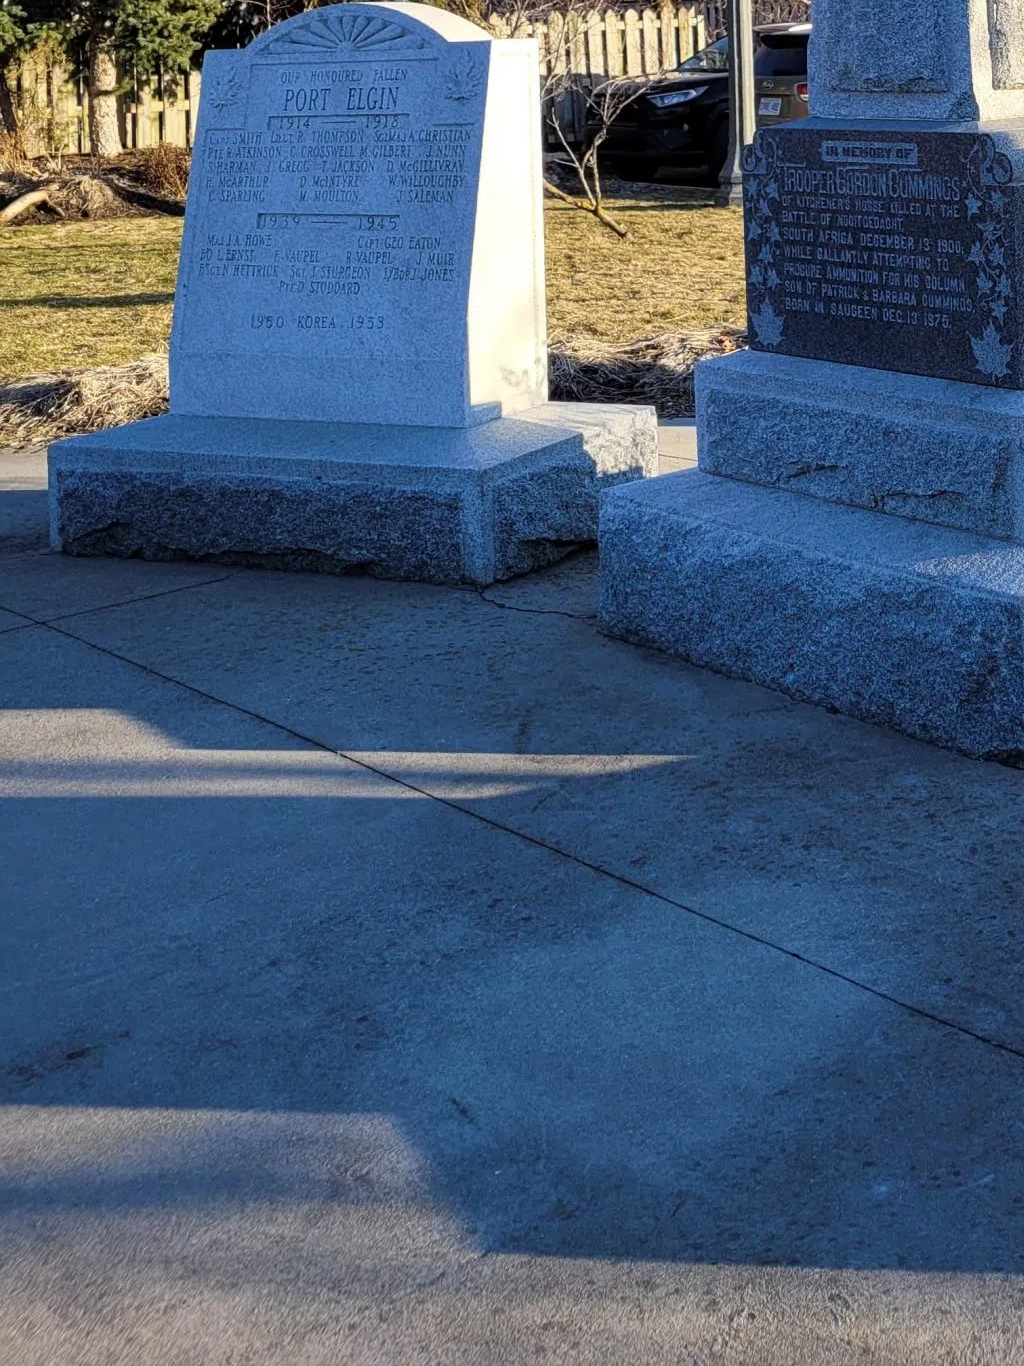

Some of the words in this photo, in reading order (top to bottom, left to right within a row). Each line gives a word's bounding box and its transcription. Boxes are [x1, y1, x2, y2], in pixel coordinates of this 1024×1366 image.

[281, 71, 300, 84] OUR
[310, 69, 363, 83] HONOURED
[373, 68, 408, 83] FALLEN
[283, 87, 332, 112] PORT
[346, 85, 400, 111] ELGIN
[279, 116, 311, 130] 1914
[364, 114, 399, 129] 1918
[312, 130, 363, 144] THOMPSON
[419, 128, 471, 143] CHRISTIAN
[236, 145, 281, 159] ATKINSON
[301, 144, 355, 158] CROSSWELL
[372, 144, 412, 158] GILBERT
[437, 143, 466, 157] NUNN
[826, 145, 839, 157] IN
[843, 145, 891, 160] MEMORY
[896, 147, 914, 160] OF
[332, 159, 375, 174] JACKSON
[401, 173, 466, 188] WILLOUGHBY
[778, 162, 835, 194] TROOPER
[836, 166, 887, 197] GORDON
[888, 168, 960, 201] CUMMINGS
[219, 189, 266, 204] SPARLING
[781, 195, 793, 207] OF
[855, 200, 887, 213] HORSE
[890, 201, 922, 216] KILLED
[925, 203, 938, 217] AT
[941, 204, 961, 218] THE
[262, 215, 300, 229] 1939
[359, 215, 398, 231] 1945
[782, 210, 817, 225] BATTLE
[821, 213, 833, 226] OF
[245, 233, 273, 247] HOWE
[408, 235, 442, 250] EATON
[783, 226, 815, 242] SOUTH
[819, 229, 854, 246] AFRICA
[859, 232, 915, 250] DECEMBER
[428, 252, 455, 267] MUIR
[783, 243, 813, 259] WHILE
[816, 246, 869, 265] GALLANTLY
[873, 252, 932, 270] ATTEMPTING
[936, 257, 949, 272] TO
[320, 265, 372, 280] STURGEON
[421, 268, 456, 283] JONES
[783, 262, 822, 279] PROCURE
[826, 265, 879, 285] AMMUNITION
[882, 271, 901, 286] FOR
[904, 273, 920, 288] HIS
[309, 280, 361, 296] STODDARD
[784, 279, 802, 294] SON
[806, 282, 817, 295] OF
[821, 283, 860, 300] PATRICK
[862, 289, 869, 301] &
[872, 288, 917, 306] BARBARA
[785, 297, 810, 312] BORN
[814, 300, 825, 314] IN
[830, 302, 878, 320] SAUGEEN
[250, 313, 285, 330] 1950
[297, 314, 337, 330] KOREA
[349, 314, 385, 331] 1953
